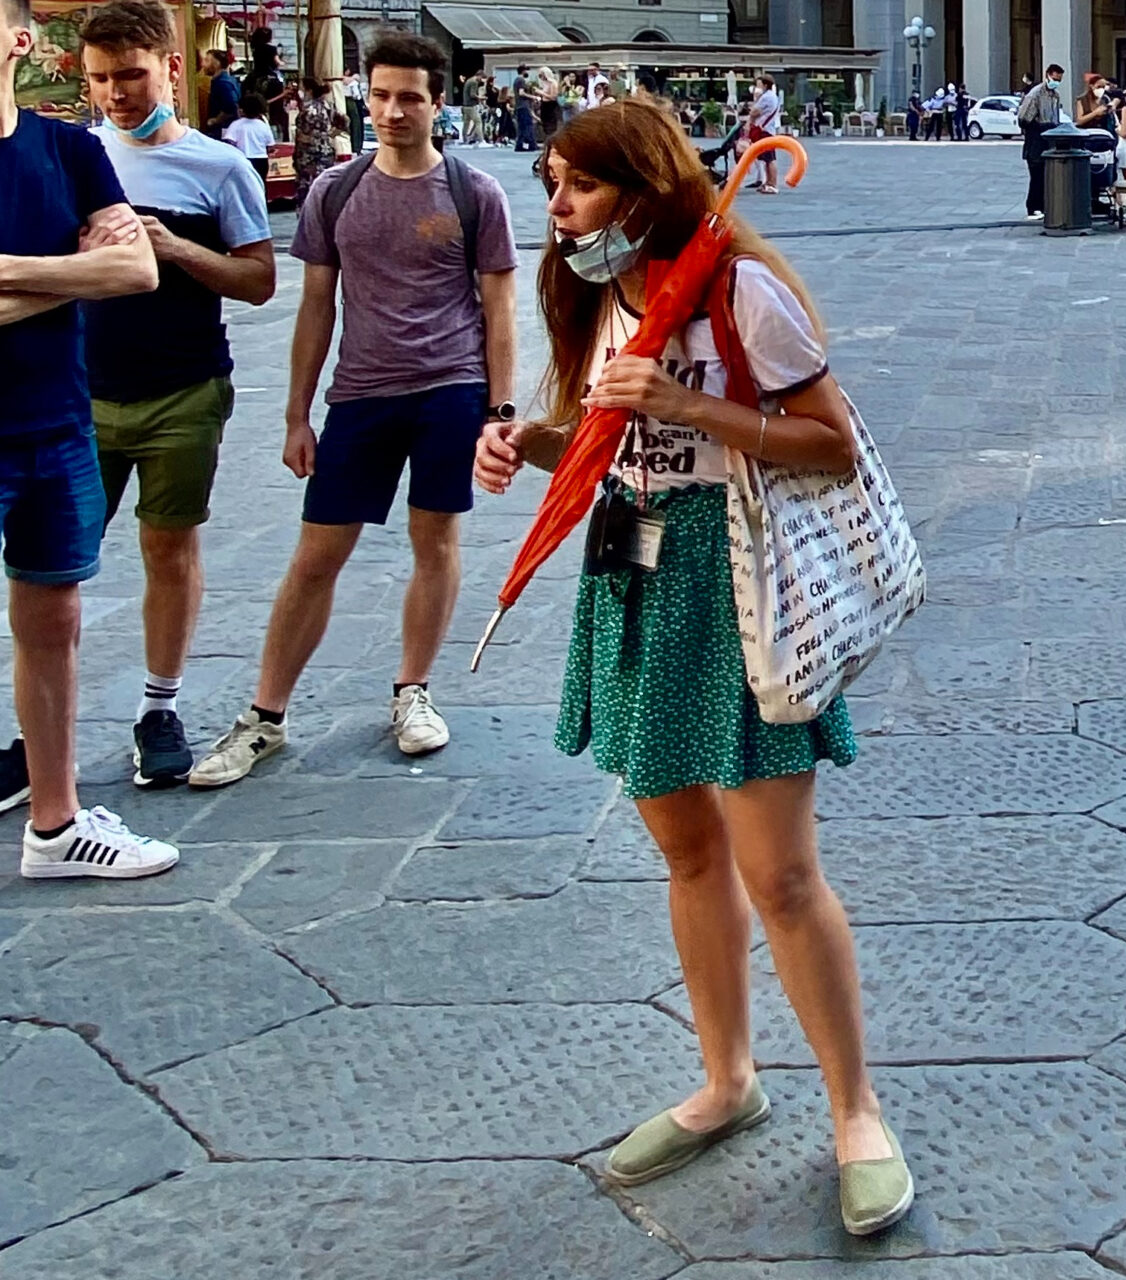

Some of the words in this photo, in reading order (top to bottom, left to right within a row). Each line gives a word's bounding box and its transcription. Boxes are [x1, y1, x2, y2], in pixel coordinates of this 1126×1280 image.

[658, 425, 709, 442] can't
[821, 506, 835, 519] OF
[848, 519, 853, 530] I
[857, 507, 872, 527] AM
[847, 538, 863, 555] AM
[850, 563, 863, 576] OF
[786, 674, 790, 686] I
[795, 660, 814, 683] AM
[869, 622, 880, 637] OF
[796, 634, 822, 660] FEEL
